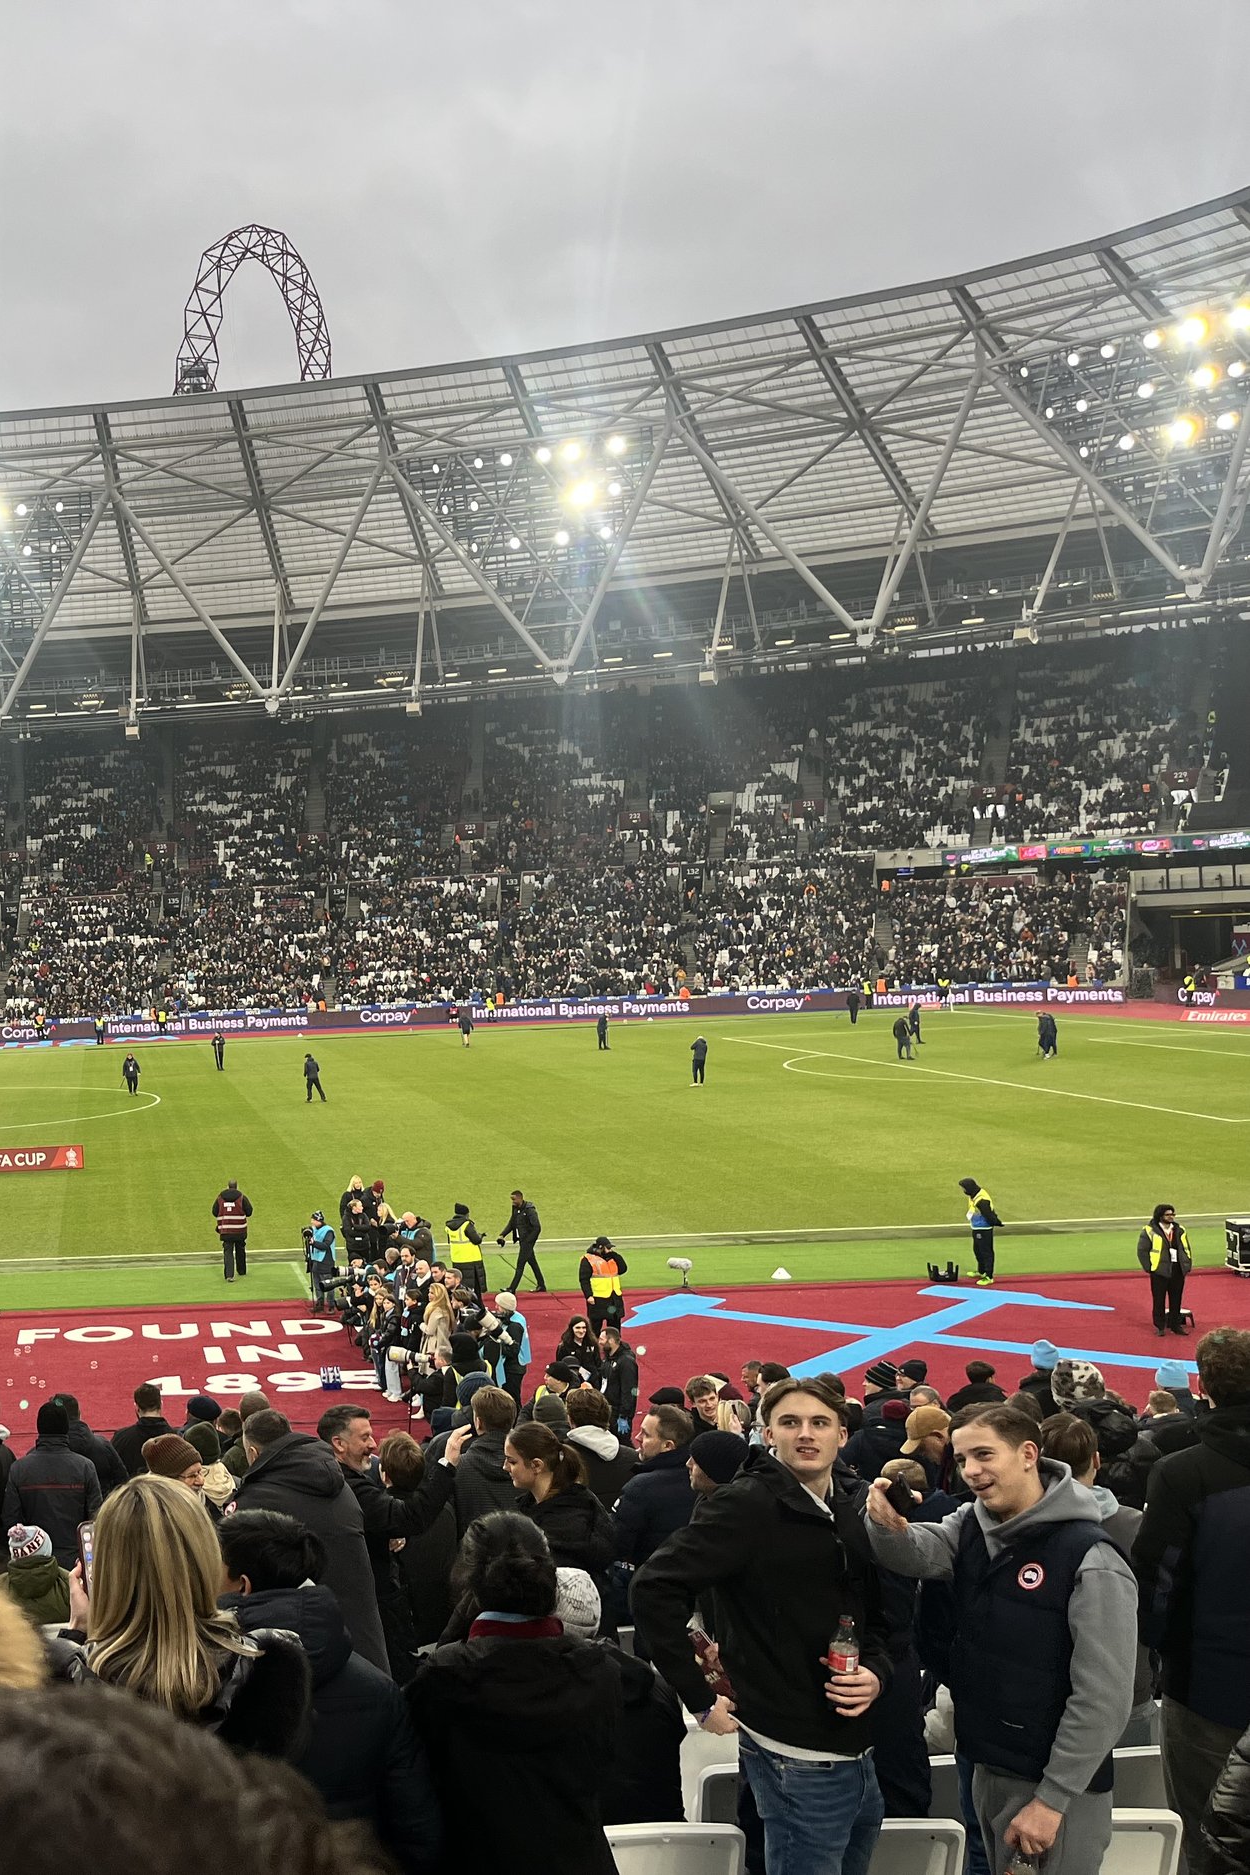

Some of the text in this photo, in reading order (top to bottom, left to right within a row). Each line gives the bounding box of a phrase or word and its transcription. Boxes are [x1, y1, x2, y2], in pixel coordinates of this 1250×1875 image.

[1210, 838, 1235, 846] SNACK
[747, 996, 804, 1011] Corpay
[974, 989, 1043, 1003] Business
[1047, 988, 1122, 1004] Payments
[1178, 988, 1216, 1006] Crpay
[560, 1000, 619, 1016] Business
[623, 1000, 689, 1016] Payments
[1188, 1011, 1247, 1021] Emirates
[108, 1014, 308, 1034] Internatinal Business Payments
[360, 1009, 412, 1024] Corpay
[14, 1152, 46, 1166] CUP
[203, 1344, 304, 1364] IN
[145, 1370, 381, 1396] 1895
